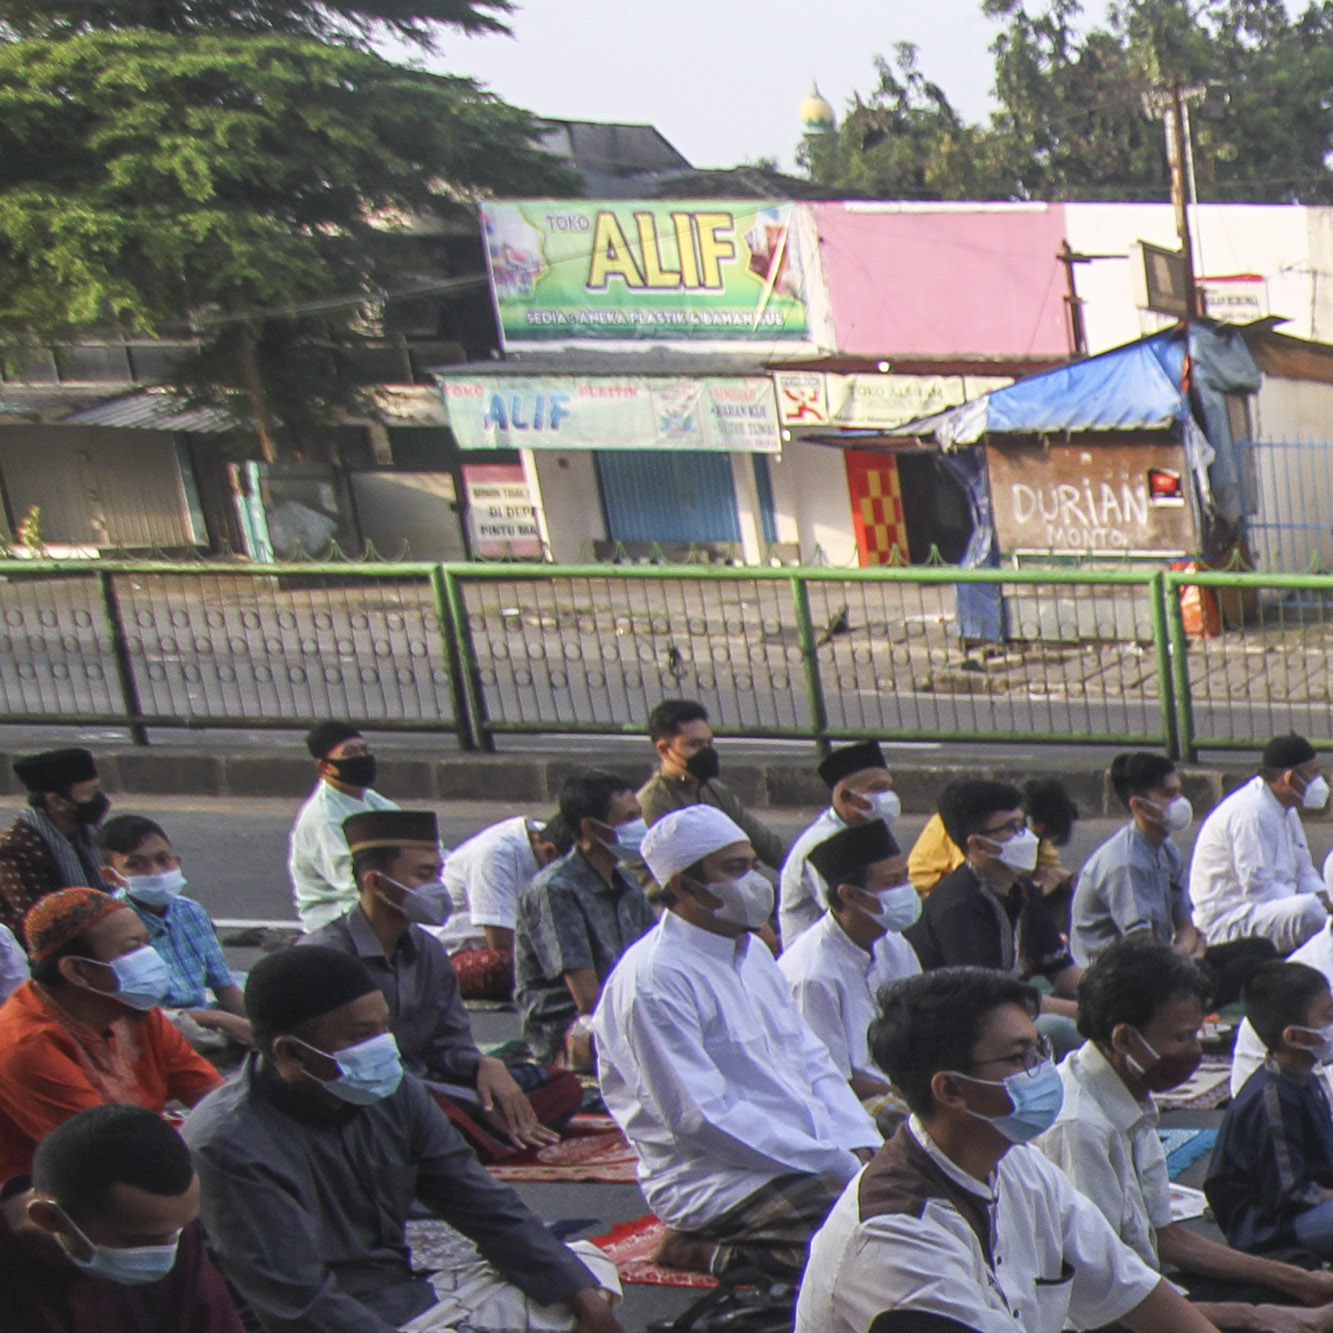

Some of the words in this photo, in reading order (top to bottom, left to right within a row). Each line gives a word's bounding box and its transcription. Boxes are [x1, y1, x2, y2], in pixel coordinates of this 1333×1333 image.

[546, 214, 591, 232] TOKO
[586, 210, 736, 291] ALIF
[578, 311, 628, 325] ANEKA
[629, 312, 686, 325] PLASTIK
[701, 312, 754, 326] BAHAN
[483, 394, 570, 431] ALIF
